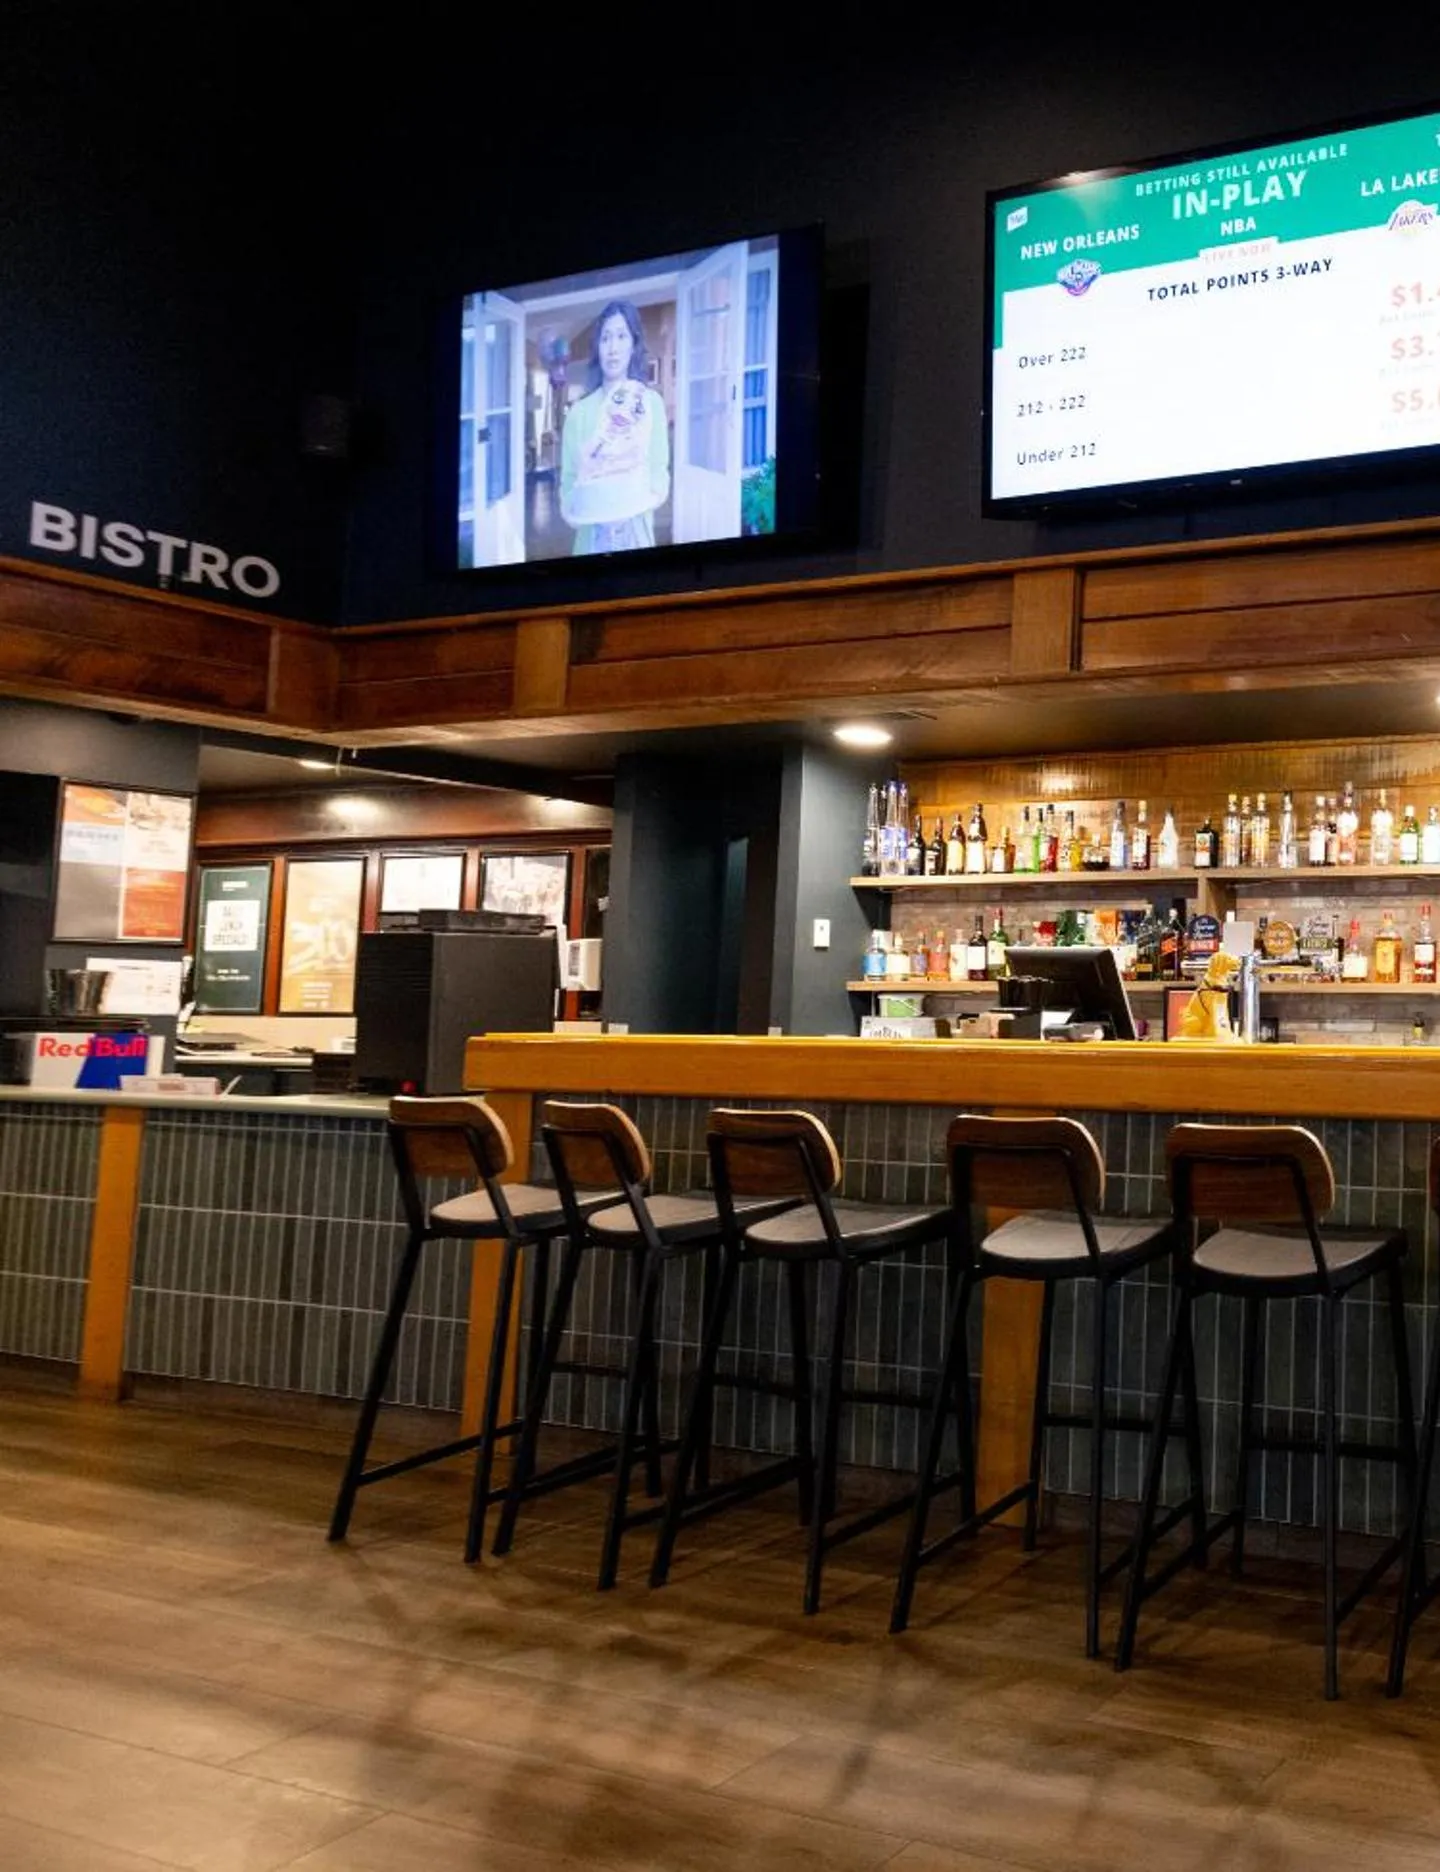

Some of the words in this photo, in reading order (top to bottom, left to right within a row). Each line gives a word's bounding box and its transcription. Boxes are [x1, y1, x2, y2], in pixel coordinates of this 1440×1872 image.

[1136, 172, 1201, 197] BETTING
[1207, 163, 1250, 184] STILL
[1257, 144, 1348, 173] AVAILABLE
[1172, 170, 1308, 220] IN-PLAY
[1361, 178, 1385, 197] LA
[1220, 216, 1257, 237] NBA
[1020, 240, 1058, 261] NEW
[1063, 224, 1141, 252] ORLEANS
[1147, 281, 1199, 301] TOTAL
[1206, 268, 1269, 291] POINTS
[1275, 257, 1333, 280] 3-WAY
[1018, 353, 1055, 369] Over
[1060, 346, 1086, 362] 222
[1017, 400, 1044, 418] 212
[1059, 394, 1086, 411] 222
[1017, 448, 1065, 466] Under
[1070, 442, 1096, 458] 212
[30, 501, 280, 598] BISTRO
[39, 1036, 94, 1058] Red
[96, 1035, 148, 1058] Bull
